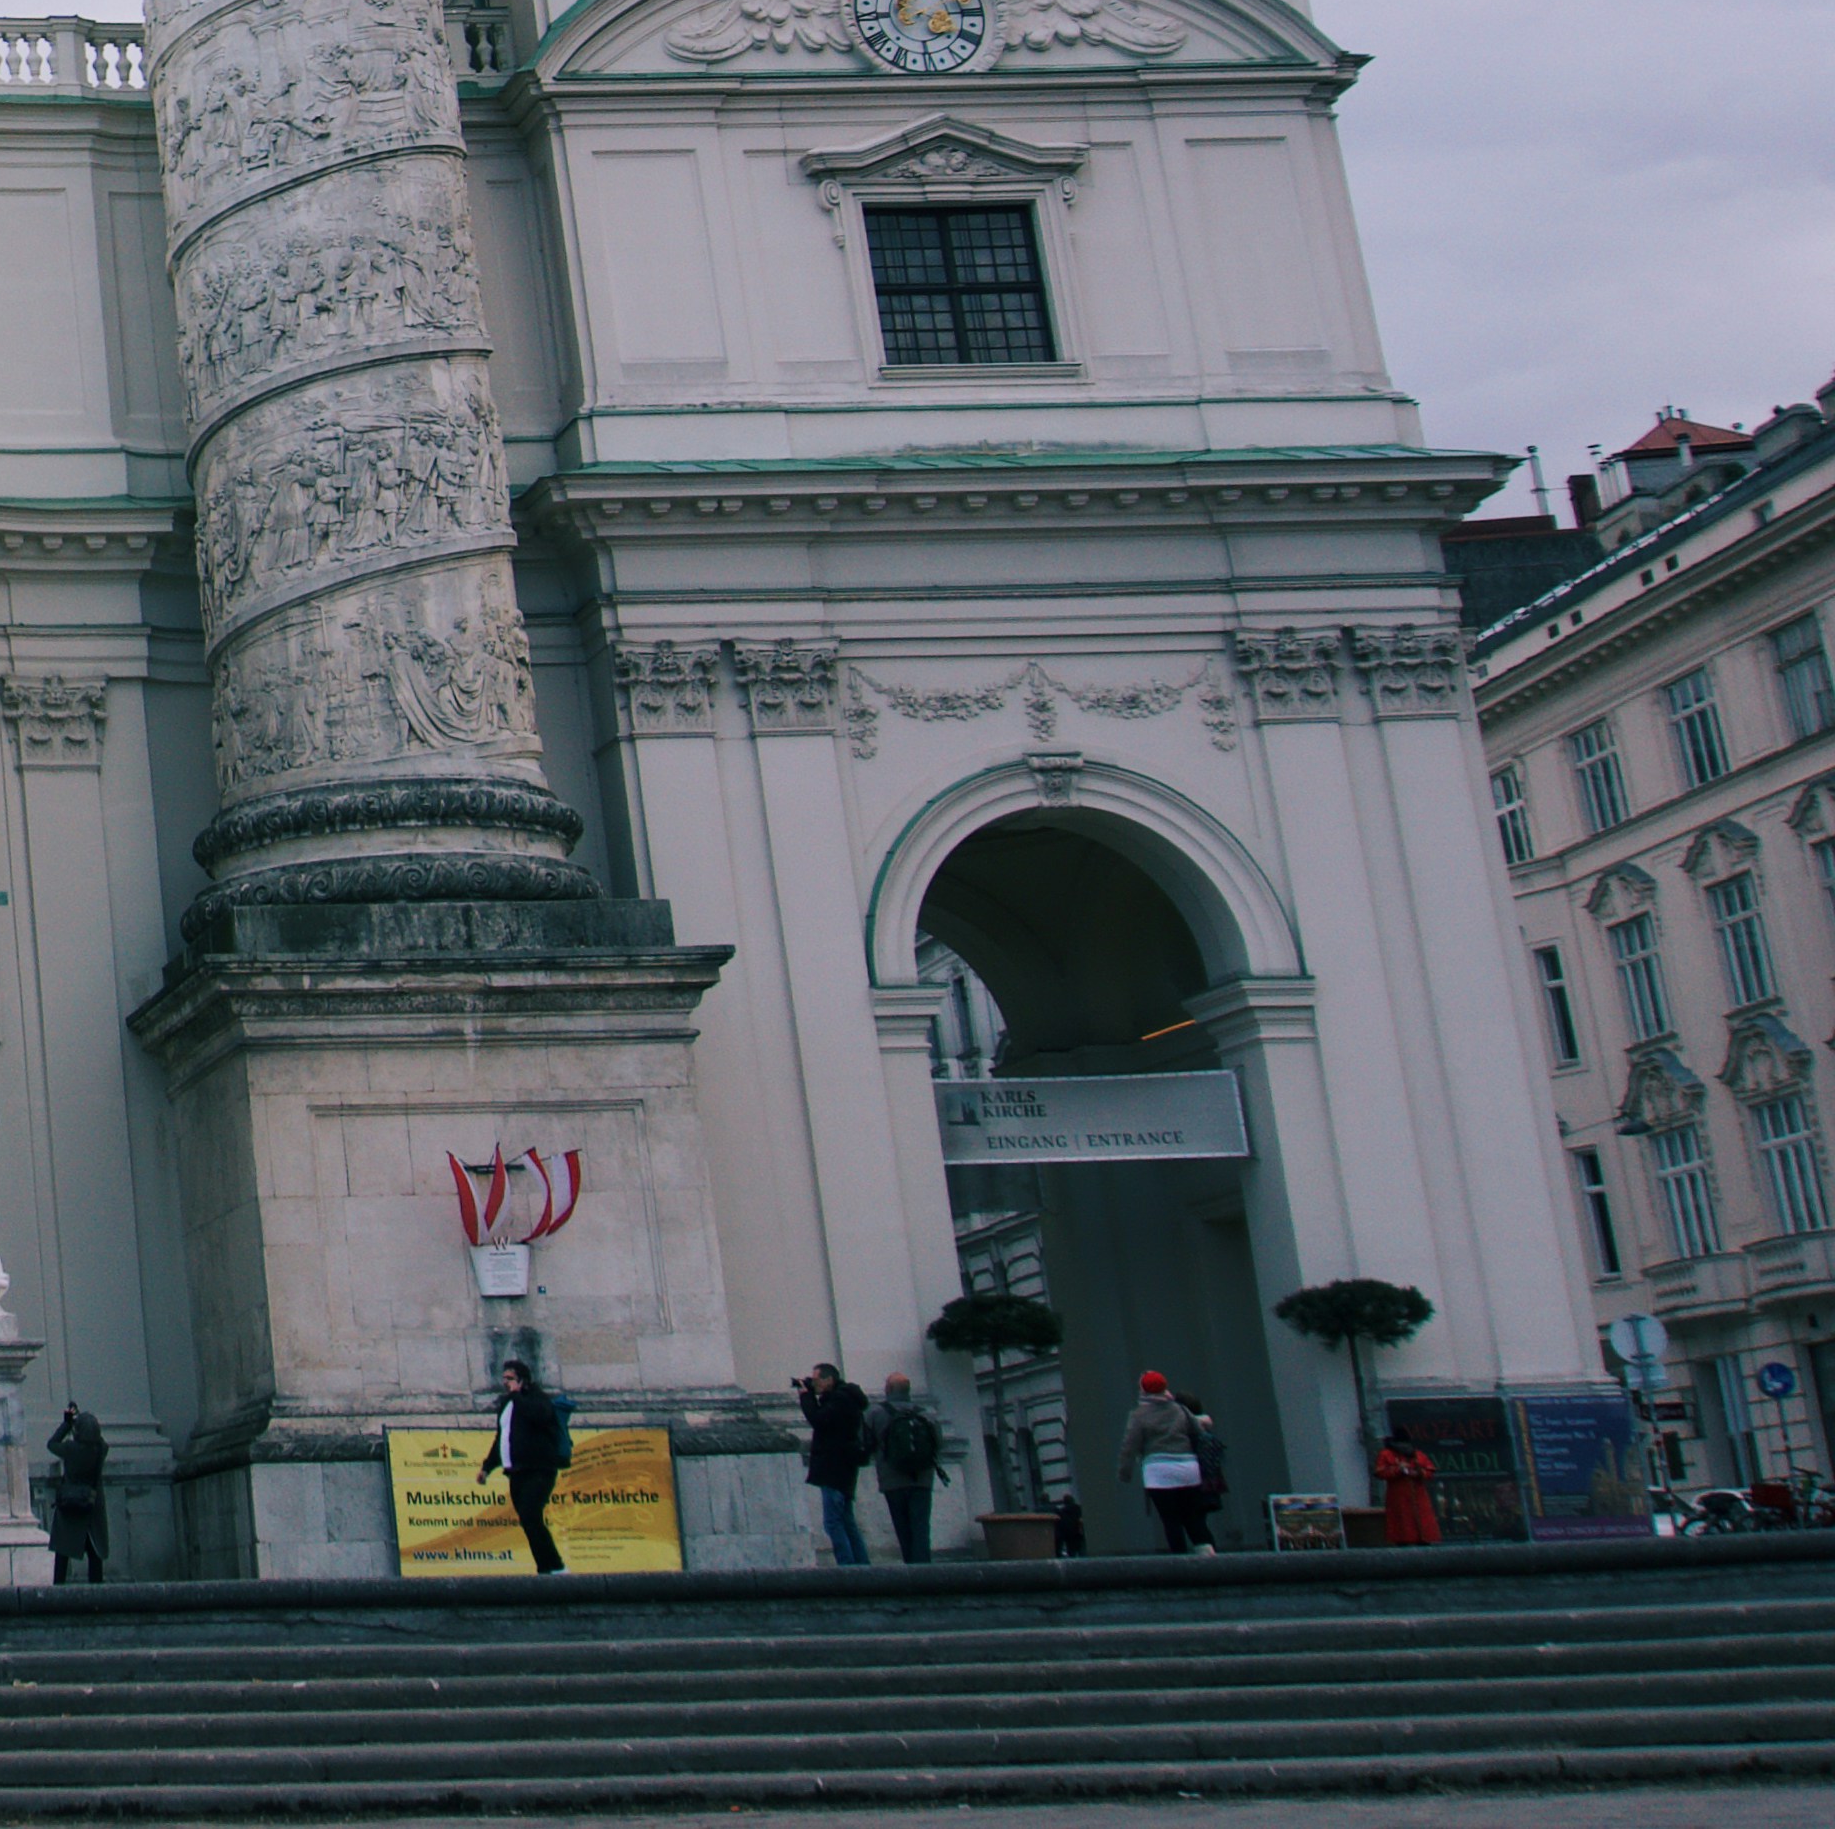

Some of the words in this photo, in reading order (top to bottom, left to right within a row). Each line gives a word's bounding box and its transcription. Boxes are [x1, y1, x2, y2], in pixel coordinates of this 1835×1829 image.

[980, 1090, 1036, 1104] KARLS
[982, 1104, 1048, 1118] KIRCHE
[986, 1135, 1068, 1150] EINGANG
[1086, 1131, 1185, 1147] ENTRANCE
[1428, 1451, 1499, 1472] VALDI
[406, 1490, 506, 1506] Musikschule
[571, 1488, 659, 1505] Karlskirche
[409, 1517, 448, 1527] Kommt
[451, 1516, 474, 1527] und
[413, 1547, 513, 1561] www.khms.at
